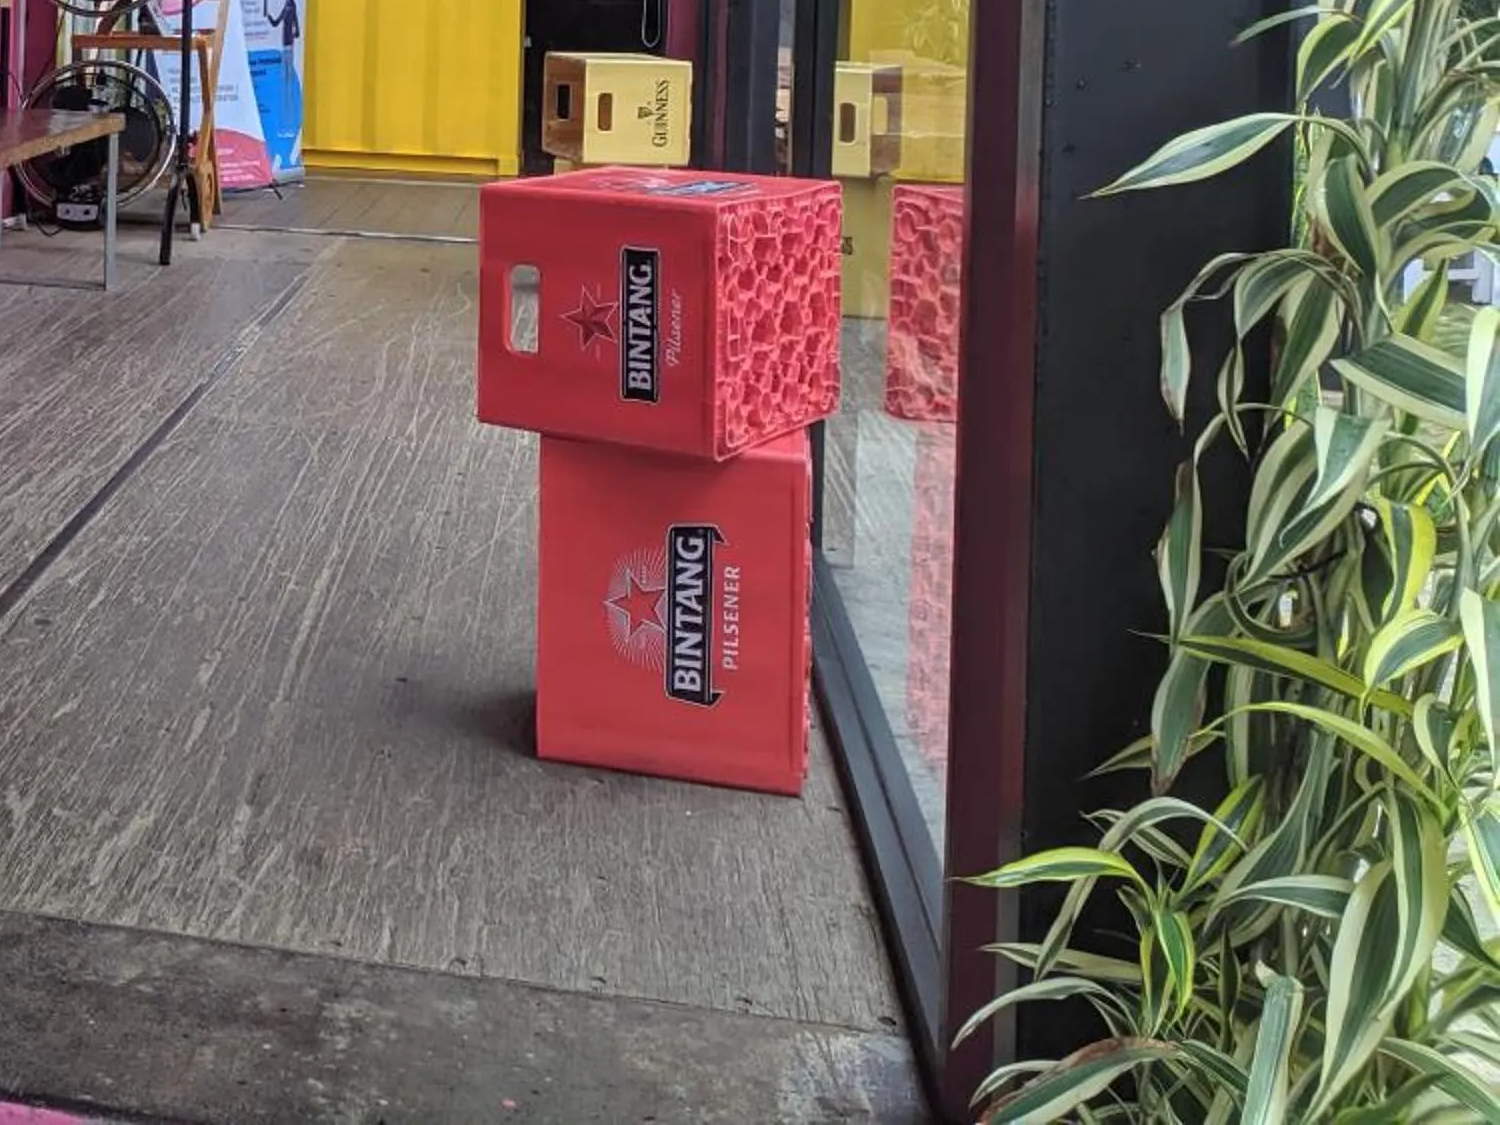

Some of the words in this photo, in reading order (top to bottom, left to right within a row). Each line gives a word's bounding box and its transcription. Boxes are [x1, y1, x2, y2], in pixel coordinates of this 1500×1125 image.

[651, 79, 671, 148] GUINNESS
[627, 262, 653, 391] BINTANG
[664, 287, 682, 368] Pilsener
[673, 535, 706, 692] BINTANG
[721, 565, 741, 671] PILSENER
